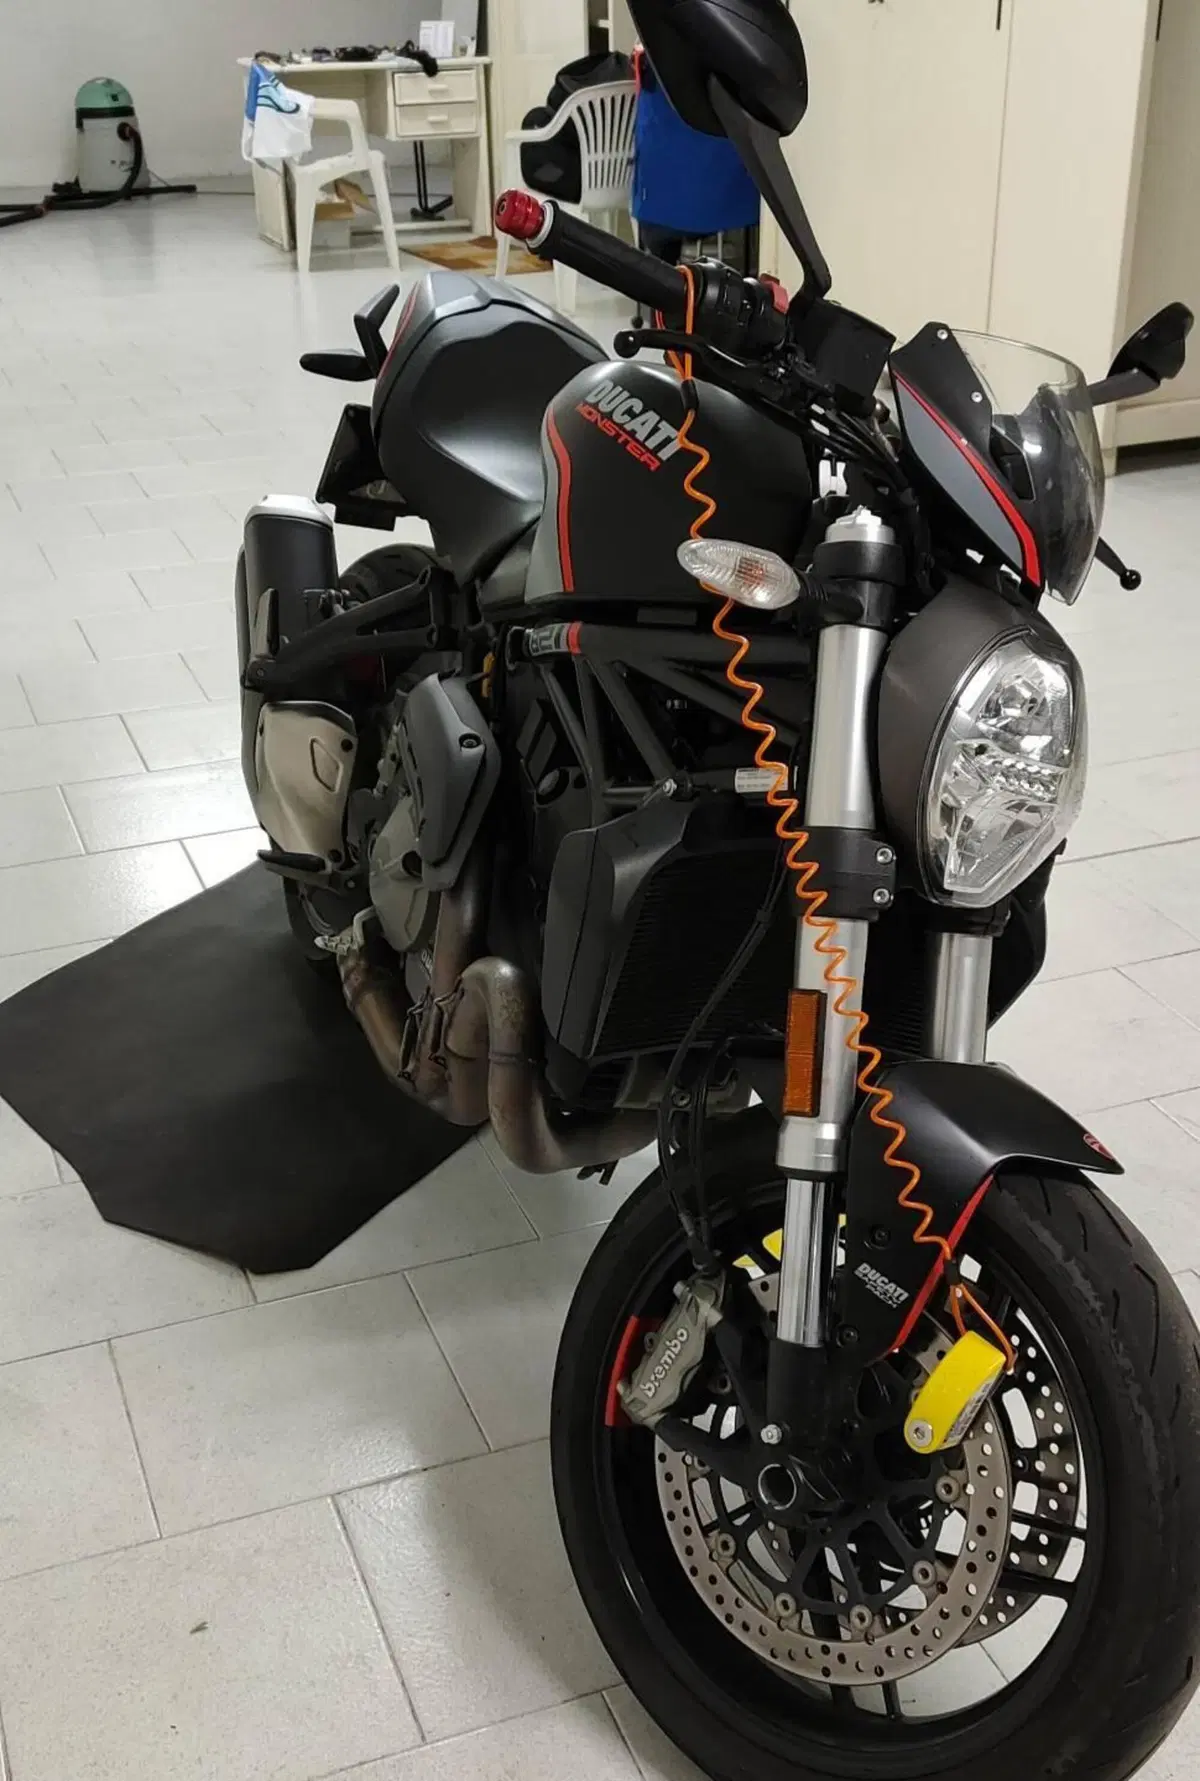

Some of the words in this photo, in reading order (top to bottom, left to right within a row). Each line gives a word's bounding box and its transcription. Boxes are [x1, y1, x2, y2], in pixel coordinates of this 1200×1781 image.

[585, 379, 683, 462] DUCATI
[856, 1262, 910, 1302] DUCATI
[639, 1327, 689, 1398] brembo
